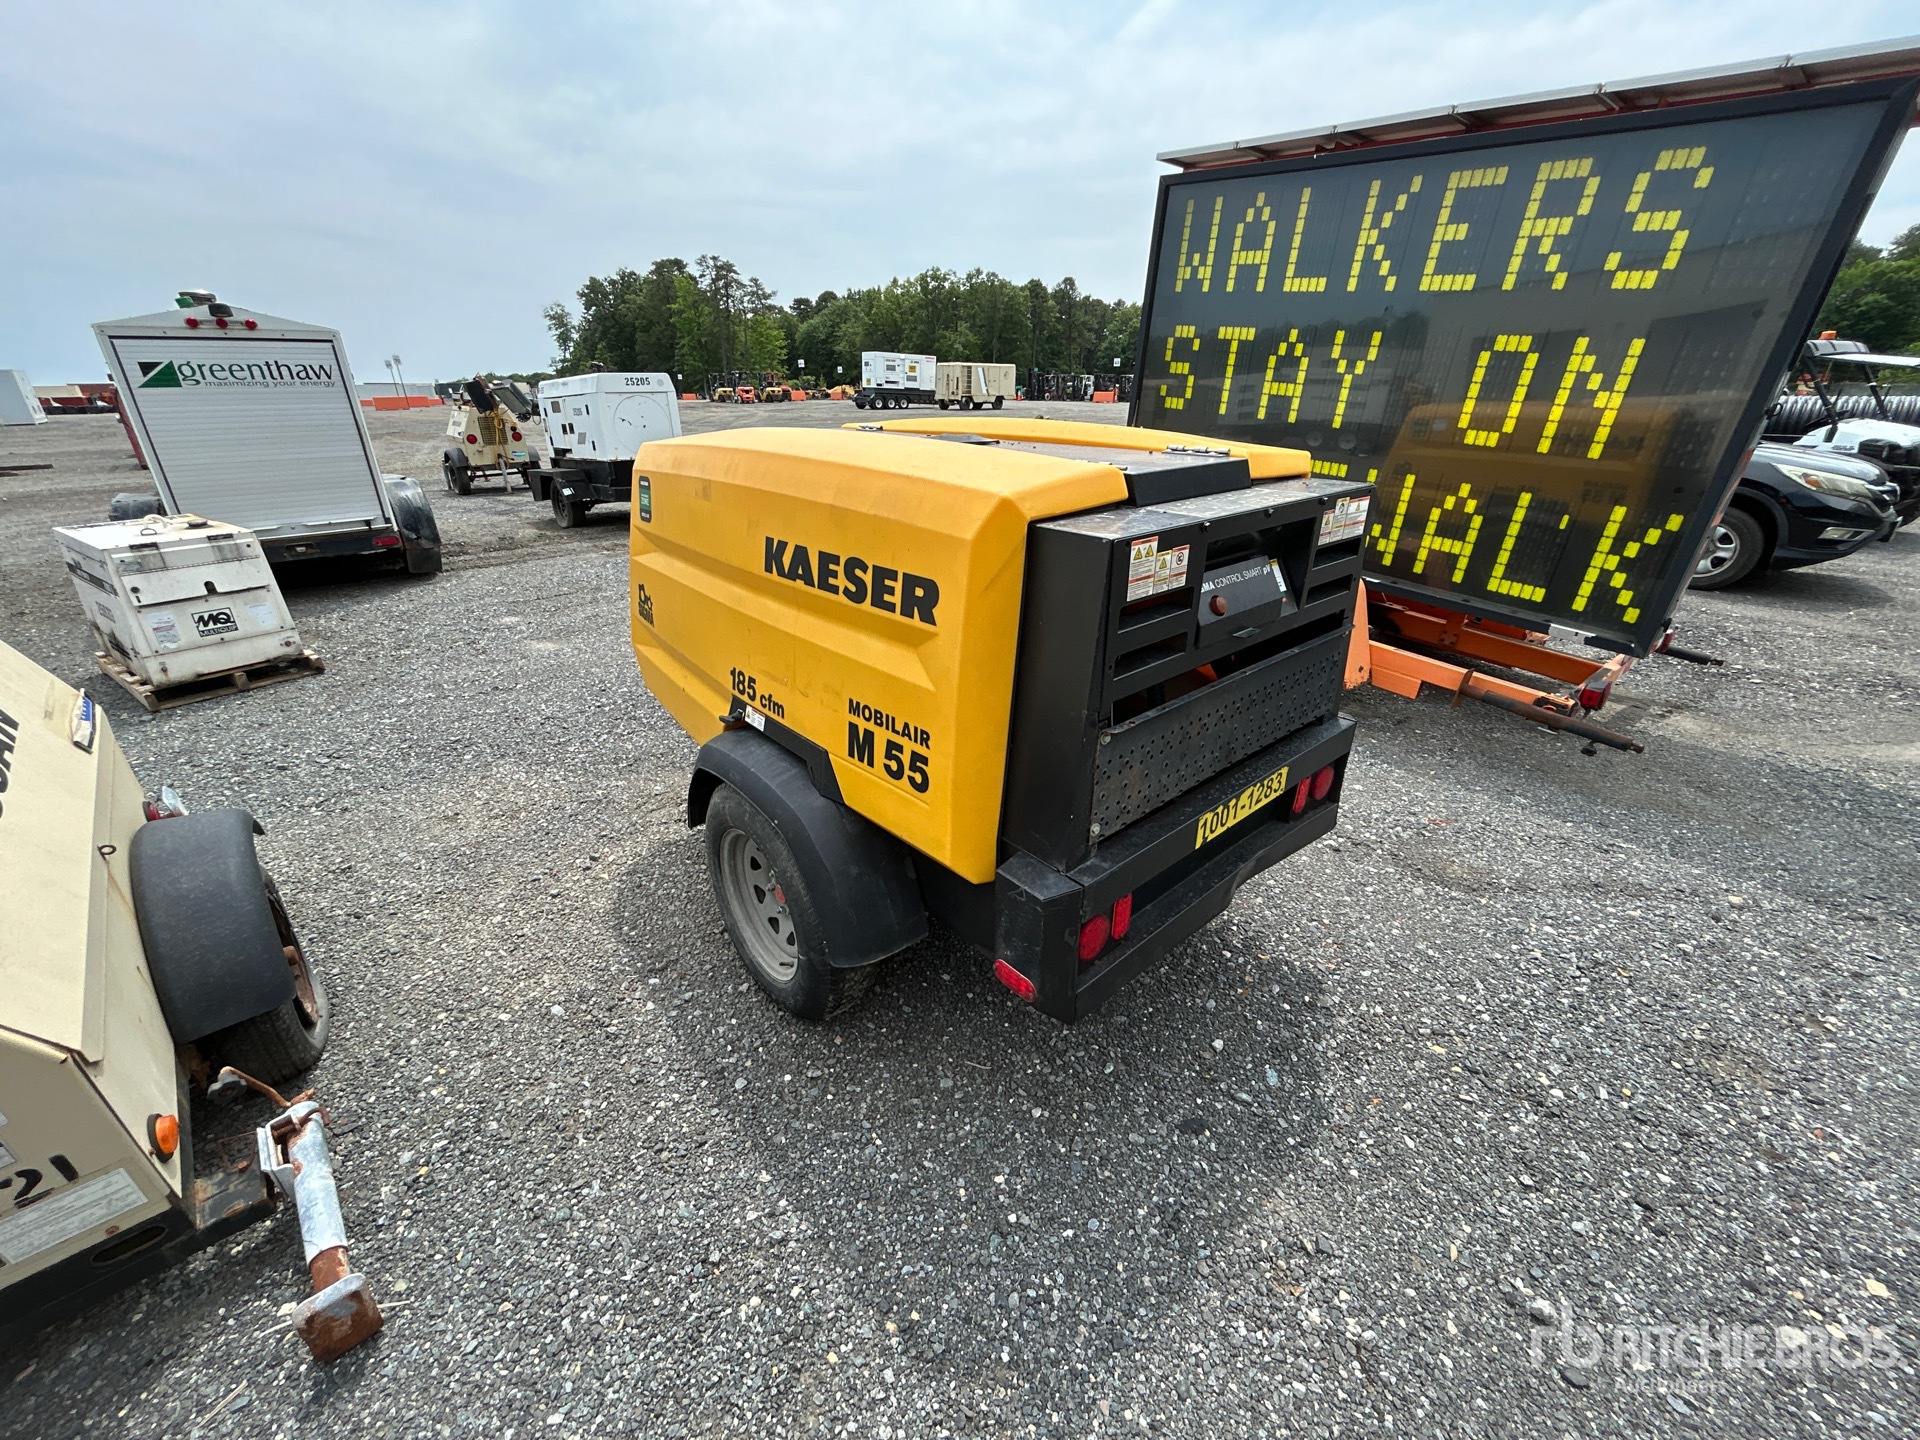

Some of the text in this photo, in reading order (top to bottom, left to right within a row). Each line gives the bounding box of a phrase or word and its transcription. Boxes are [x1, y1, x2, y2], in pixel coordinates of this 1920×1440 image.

[1175, 146, 1715, 292] WALKERS
[177, 360, 333, 386] greenthaw
[205, 379, 336, 388] maximizing your energy
[624, 377, 651, 386] 25205
[1160, 324, 1645, 459] STAY ON
[1309, 459, 1684, 623] WALK
[764, 535, 940, 627] KAESER
[1214, 573, 1244, 588] CONTROL
[1243, 566, 1262, 580] SMART
[200, 625, 237, 637] MULTIQUIP
[729, 666, 757, 702] 185
[760, 693, 785, 720] cfm
[848, 697, 931, 751] MOBILAIR
[848, 720, 930, 794] M 55
